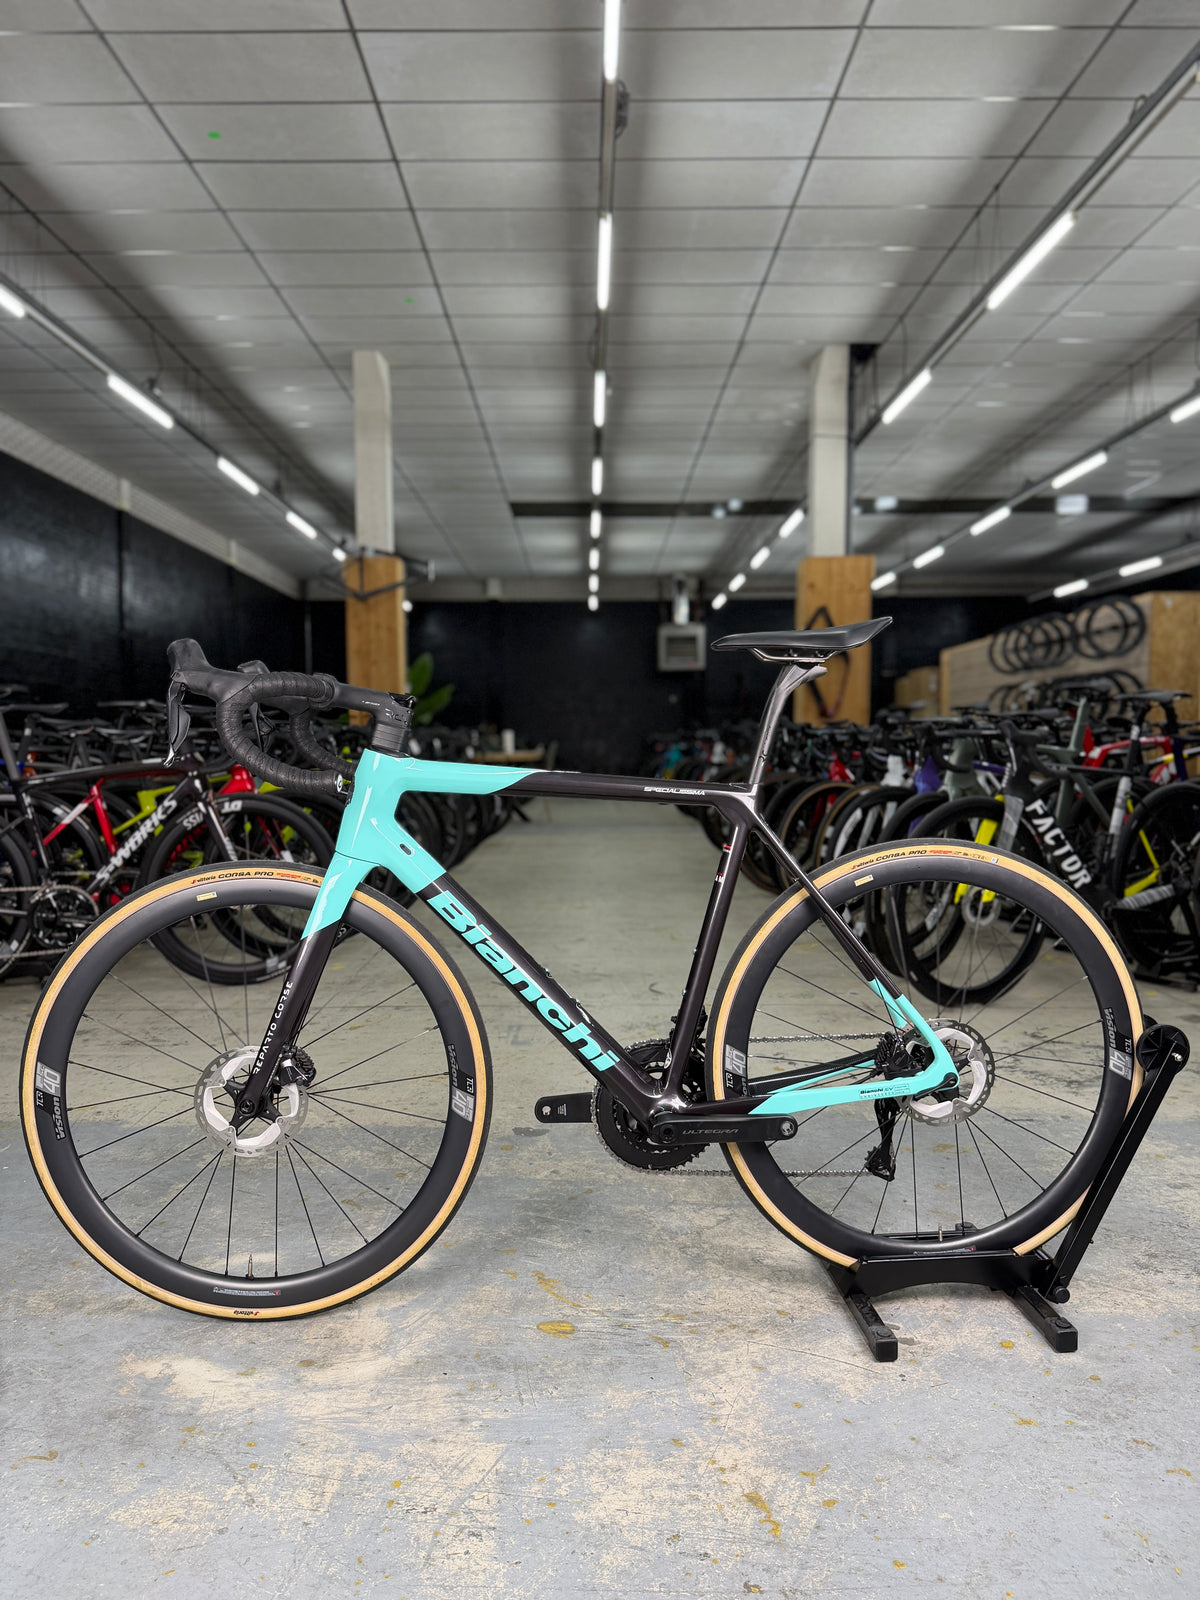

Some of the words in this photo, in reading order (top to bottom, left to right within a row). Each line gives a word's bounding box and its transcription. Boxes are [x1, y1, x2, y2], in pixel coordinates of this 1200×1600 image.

[95, 799, 178, 888] S-WORKS
[875, 852, 906, 862] CORSA
[1025, 798, 1092, 890] FACTOR
[218, 871, 251, 879] CORSA
[427, 890, 620, 1072] Bianchi
[253, 1022, 277, 1074] REPARTO
[274, 981, 293, 1019] CORSE
[732, 1049, 746, 1075] 40
[1109, 1050, 1126, 1076] 40
[43, 1068, 61, 1094] 40
[452, 1089, 467, 1117] 40
